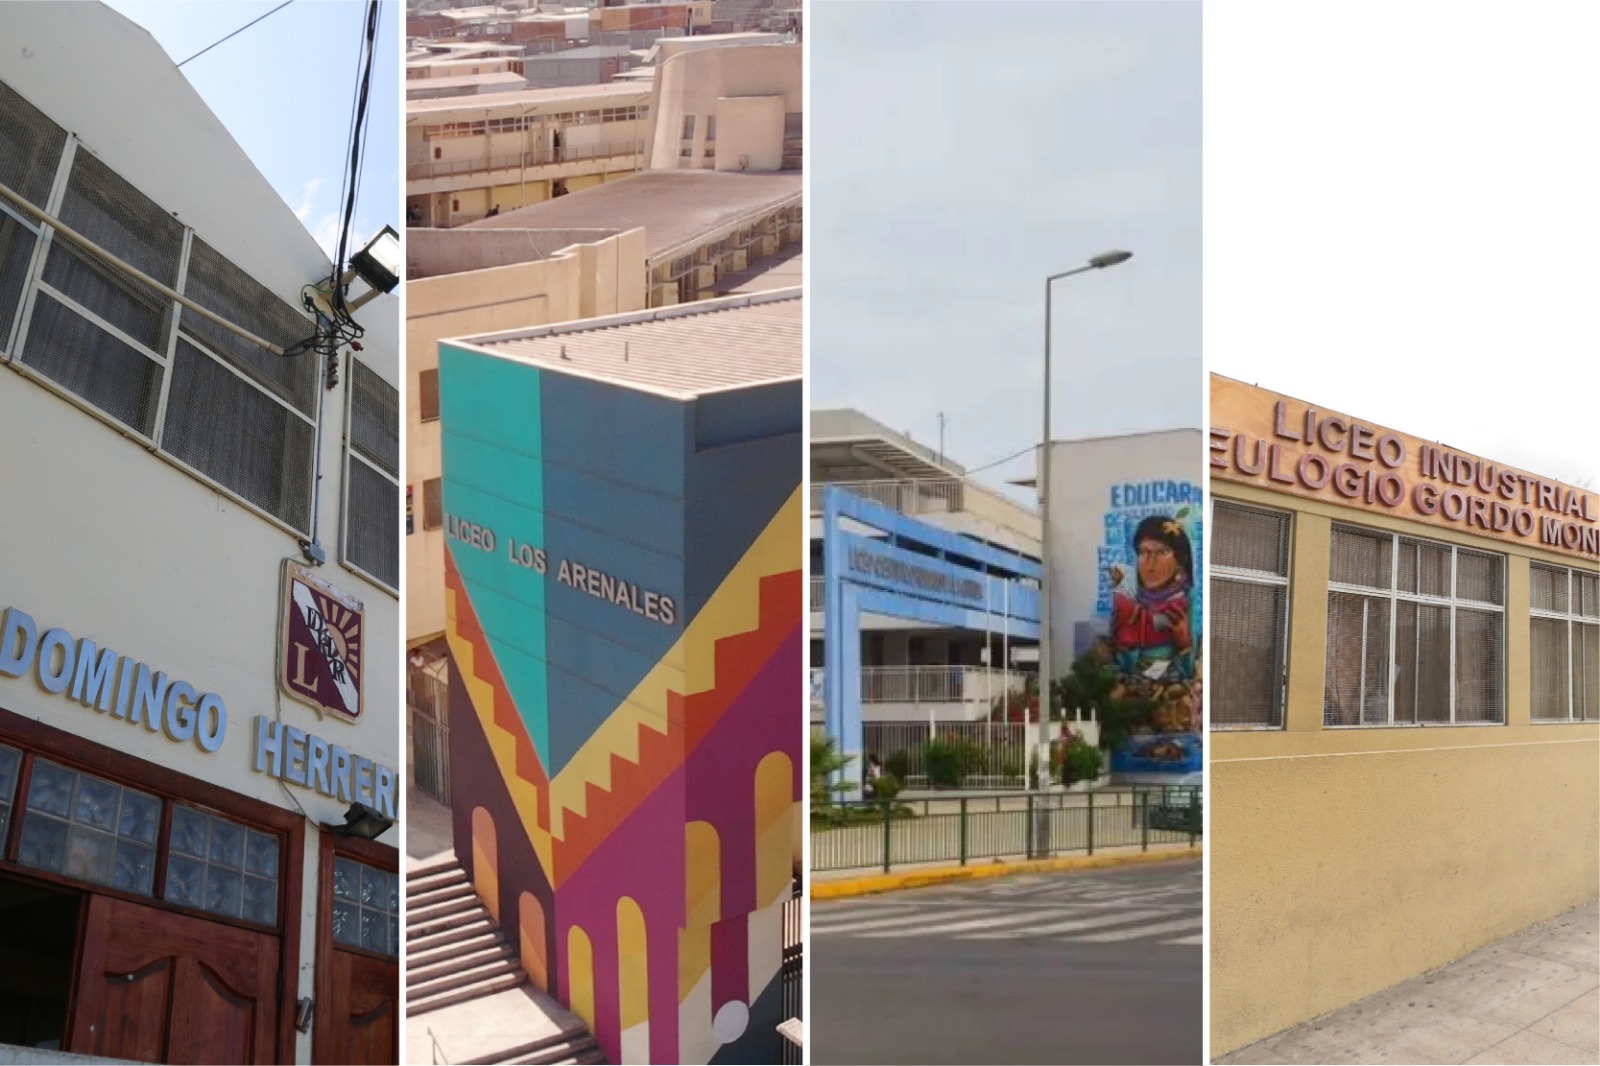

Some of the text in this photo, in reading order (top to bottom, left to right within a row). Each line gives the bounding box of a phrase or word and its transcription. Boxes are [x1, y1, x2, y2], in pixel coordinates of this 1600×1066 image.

[1210, 426, 1600, 555] EULOGIO GORDO MON
[1275, 400, 1597, 522] LICEO INDUSTRIAL
[446, 513, 676, 625] LICEO LOS ARENALES
[0, 606, 399, 822] DOMINGO HERRER
